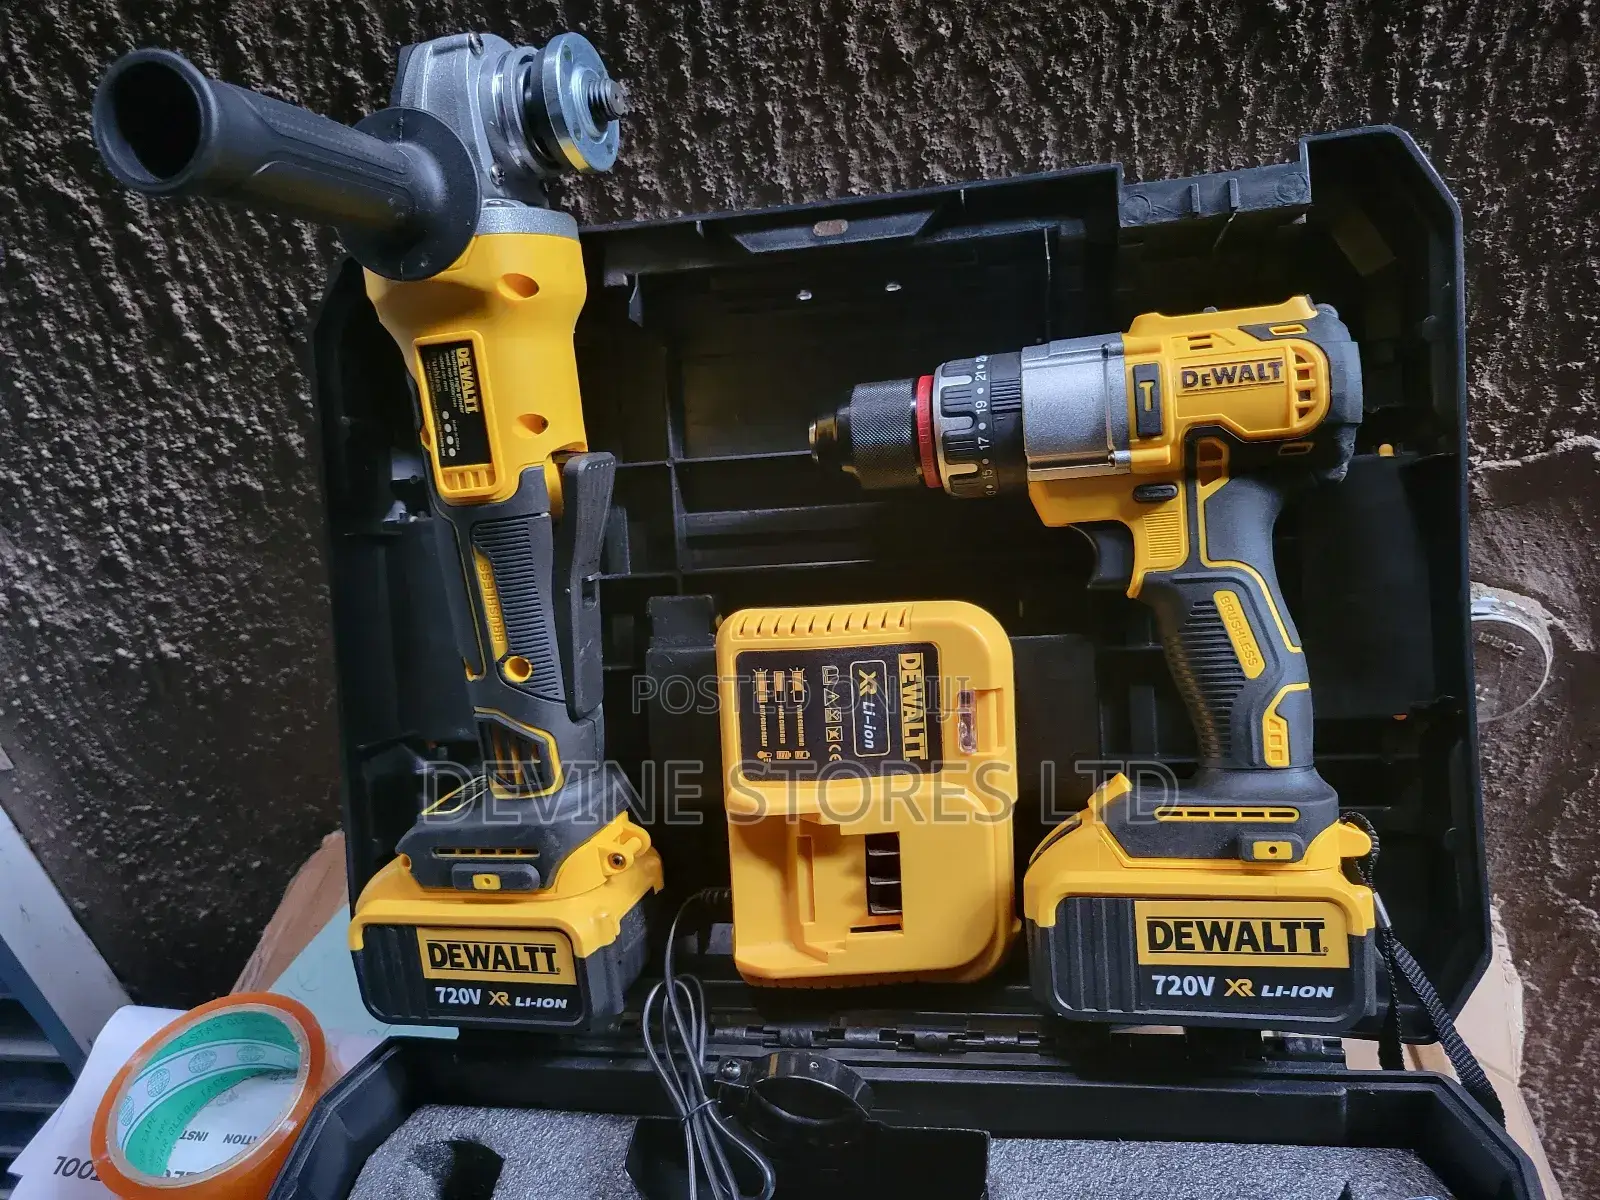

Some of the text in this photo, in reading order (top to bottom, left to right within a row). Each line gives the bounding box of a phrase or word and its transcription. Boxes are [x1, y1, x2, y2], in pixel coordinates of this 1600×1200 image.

[975, 371, 987, 381] 21
[975, 400, 988, 414] 19
[978, 437, 990, 450] 17
[982, 469, 993, 480] 15
[480, 562, 505, 643] BRUSHLESS
[1218, 594, 1259, 668] BRUSHLESS
[858, 669, 879, 750] XR Li-ion
[900, 652, 925, 762] DEWALTT
[434, 986, 568, 1009] 720V XR LI-ION
[1151, 974, 1335, 999] 720V XR LI-ION
